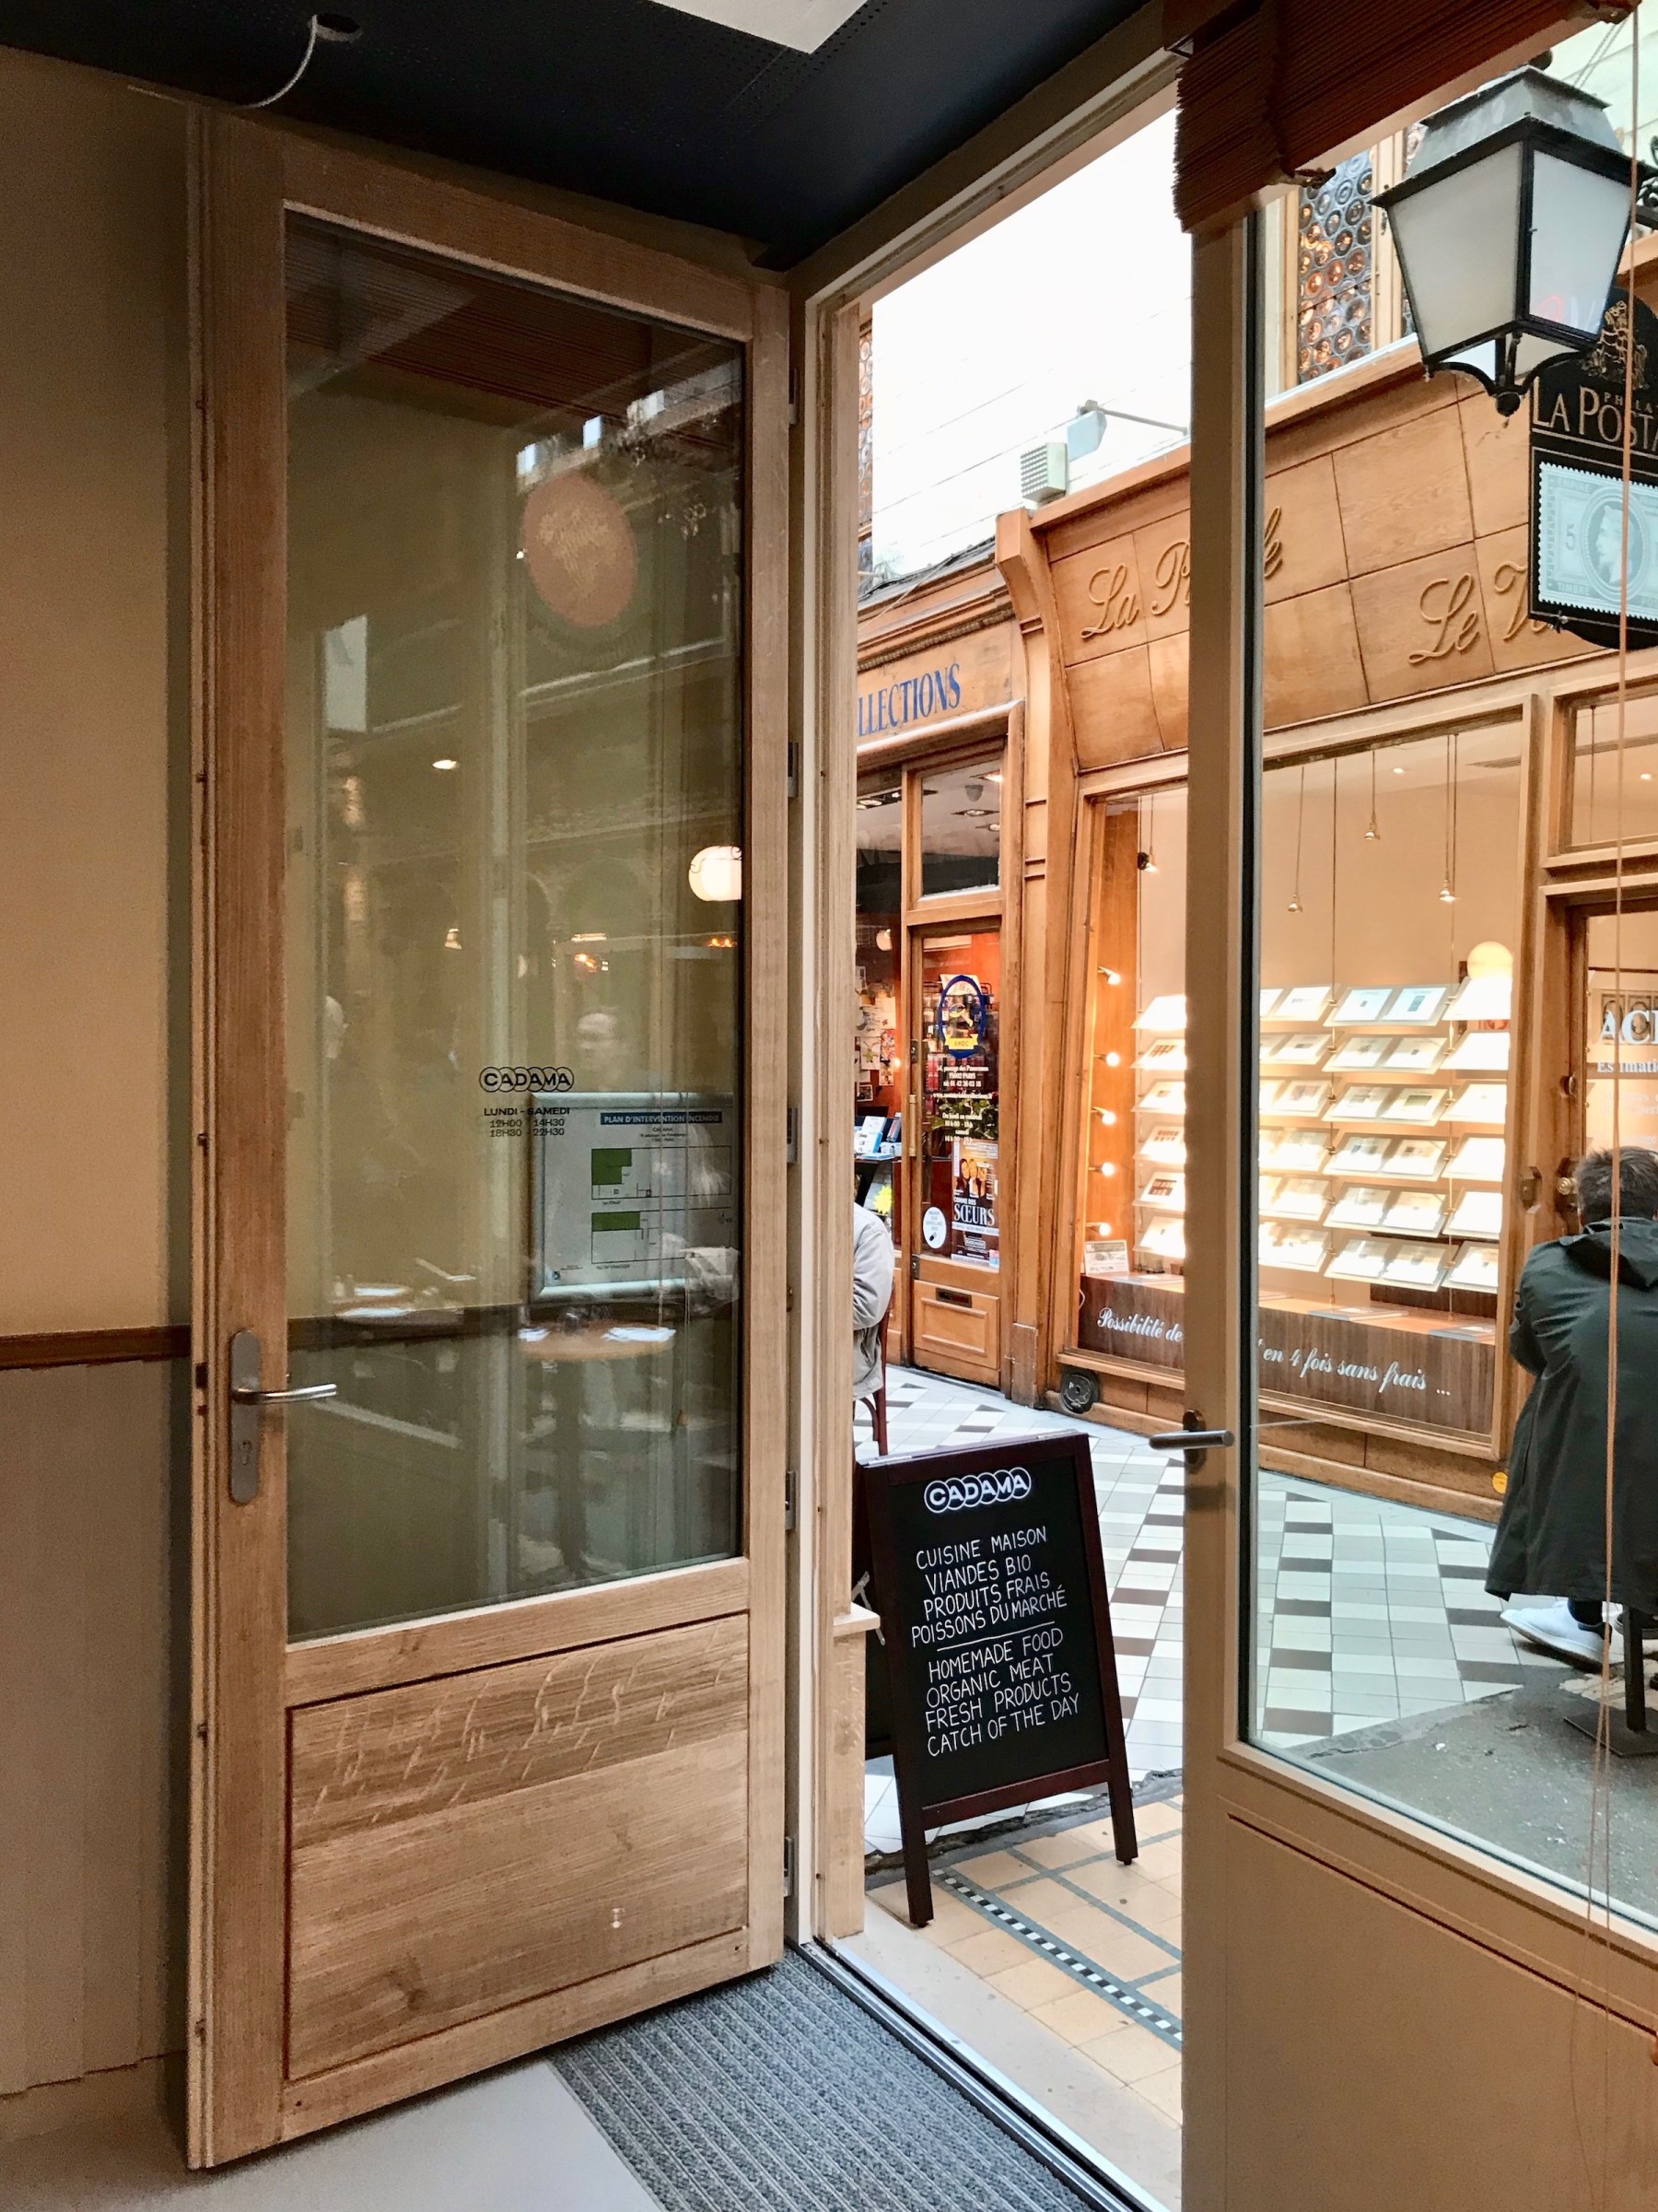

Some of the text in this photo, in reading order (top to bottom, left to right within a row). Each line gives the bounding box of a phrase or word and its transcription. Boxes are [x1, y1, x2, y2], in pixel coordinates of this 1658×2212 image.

[1533, 375, 1570, 432] LA
[1565, 523, 1576, 551] 5
[1080, 562, 1139, 639] La
[1408, 572, 1480, 664] Le
[1600, 1009, 1658, 1045] AC
[481, 1069, 573, 1091] CADAMA
[484, 1107, 518, 1117] LUNDI
[526, 1106, 571, 1116] SAMEDI
[533, 1128, 566, 1137] 22H30
[603, 1115, 624, 1123] PLAN
[1097, 1306, 1164, 1339] Possibilité
[1165, 1323, 1184, 1342] de
[1263, 1347, 1283, 1363] en
[1289, 1348, 1302, 1367] 4
[1300, 1347, 1333, 1378] fois
[1337, 1359, 1379, 1381] sans
[1378, 1361, 1427, 1394] frais
[925, 1469, 1031, 1511] CADAMA
[916, 1525, 1047, 1570] CUISINE MAISON
[923, 1571, 1050, 1621] PRODUITS FRAIS
[925, 1554, 1032, 1596] VIANDES BIO
[911, 1584, 1068, 1648] POISSONS DU MARCHÉ
[927, 1653, 1054, 1708] ORGANIC MEAT
[928, 1628, 1063, 1683] HOMEMADE FOOD
[925, 1672, 1071, 1732] FRESH PRODUCTS
[928, 1692, 1080, 1757] CATCH OF THE DAY
